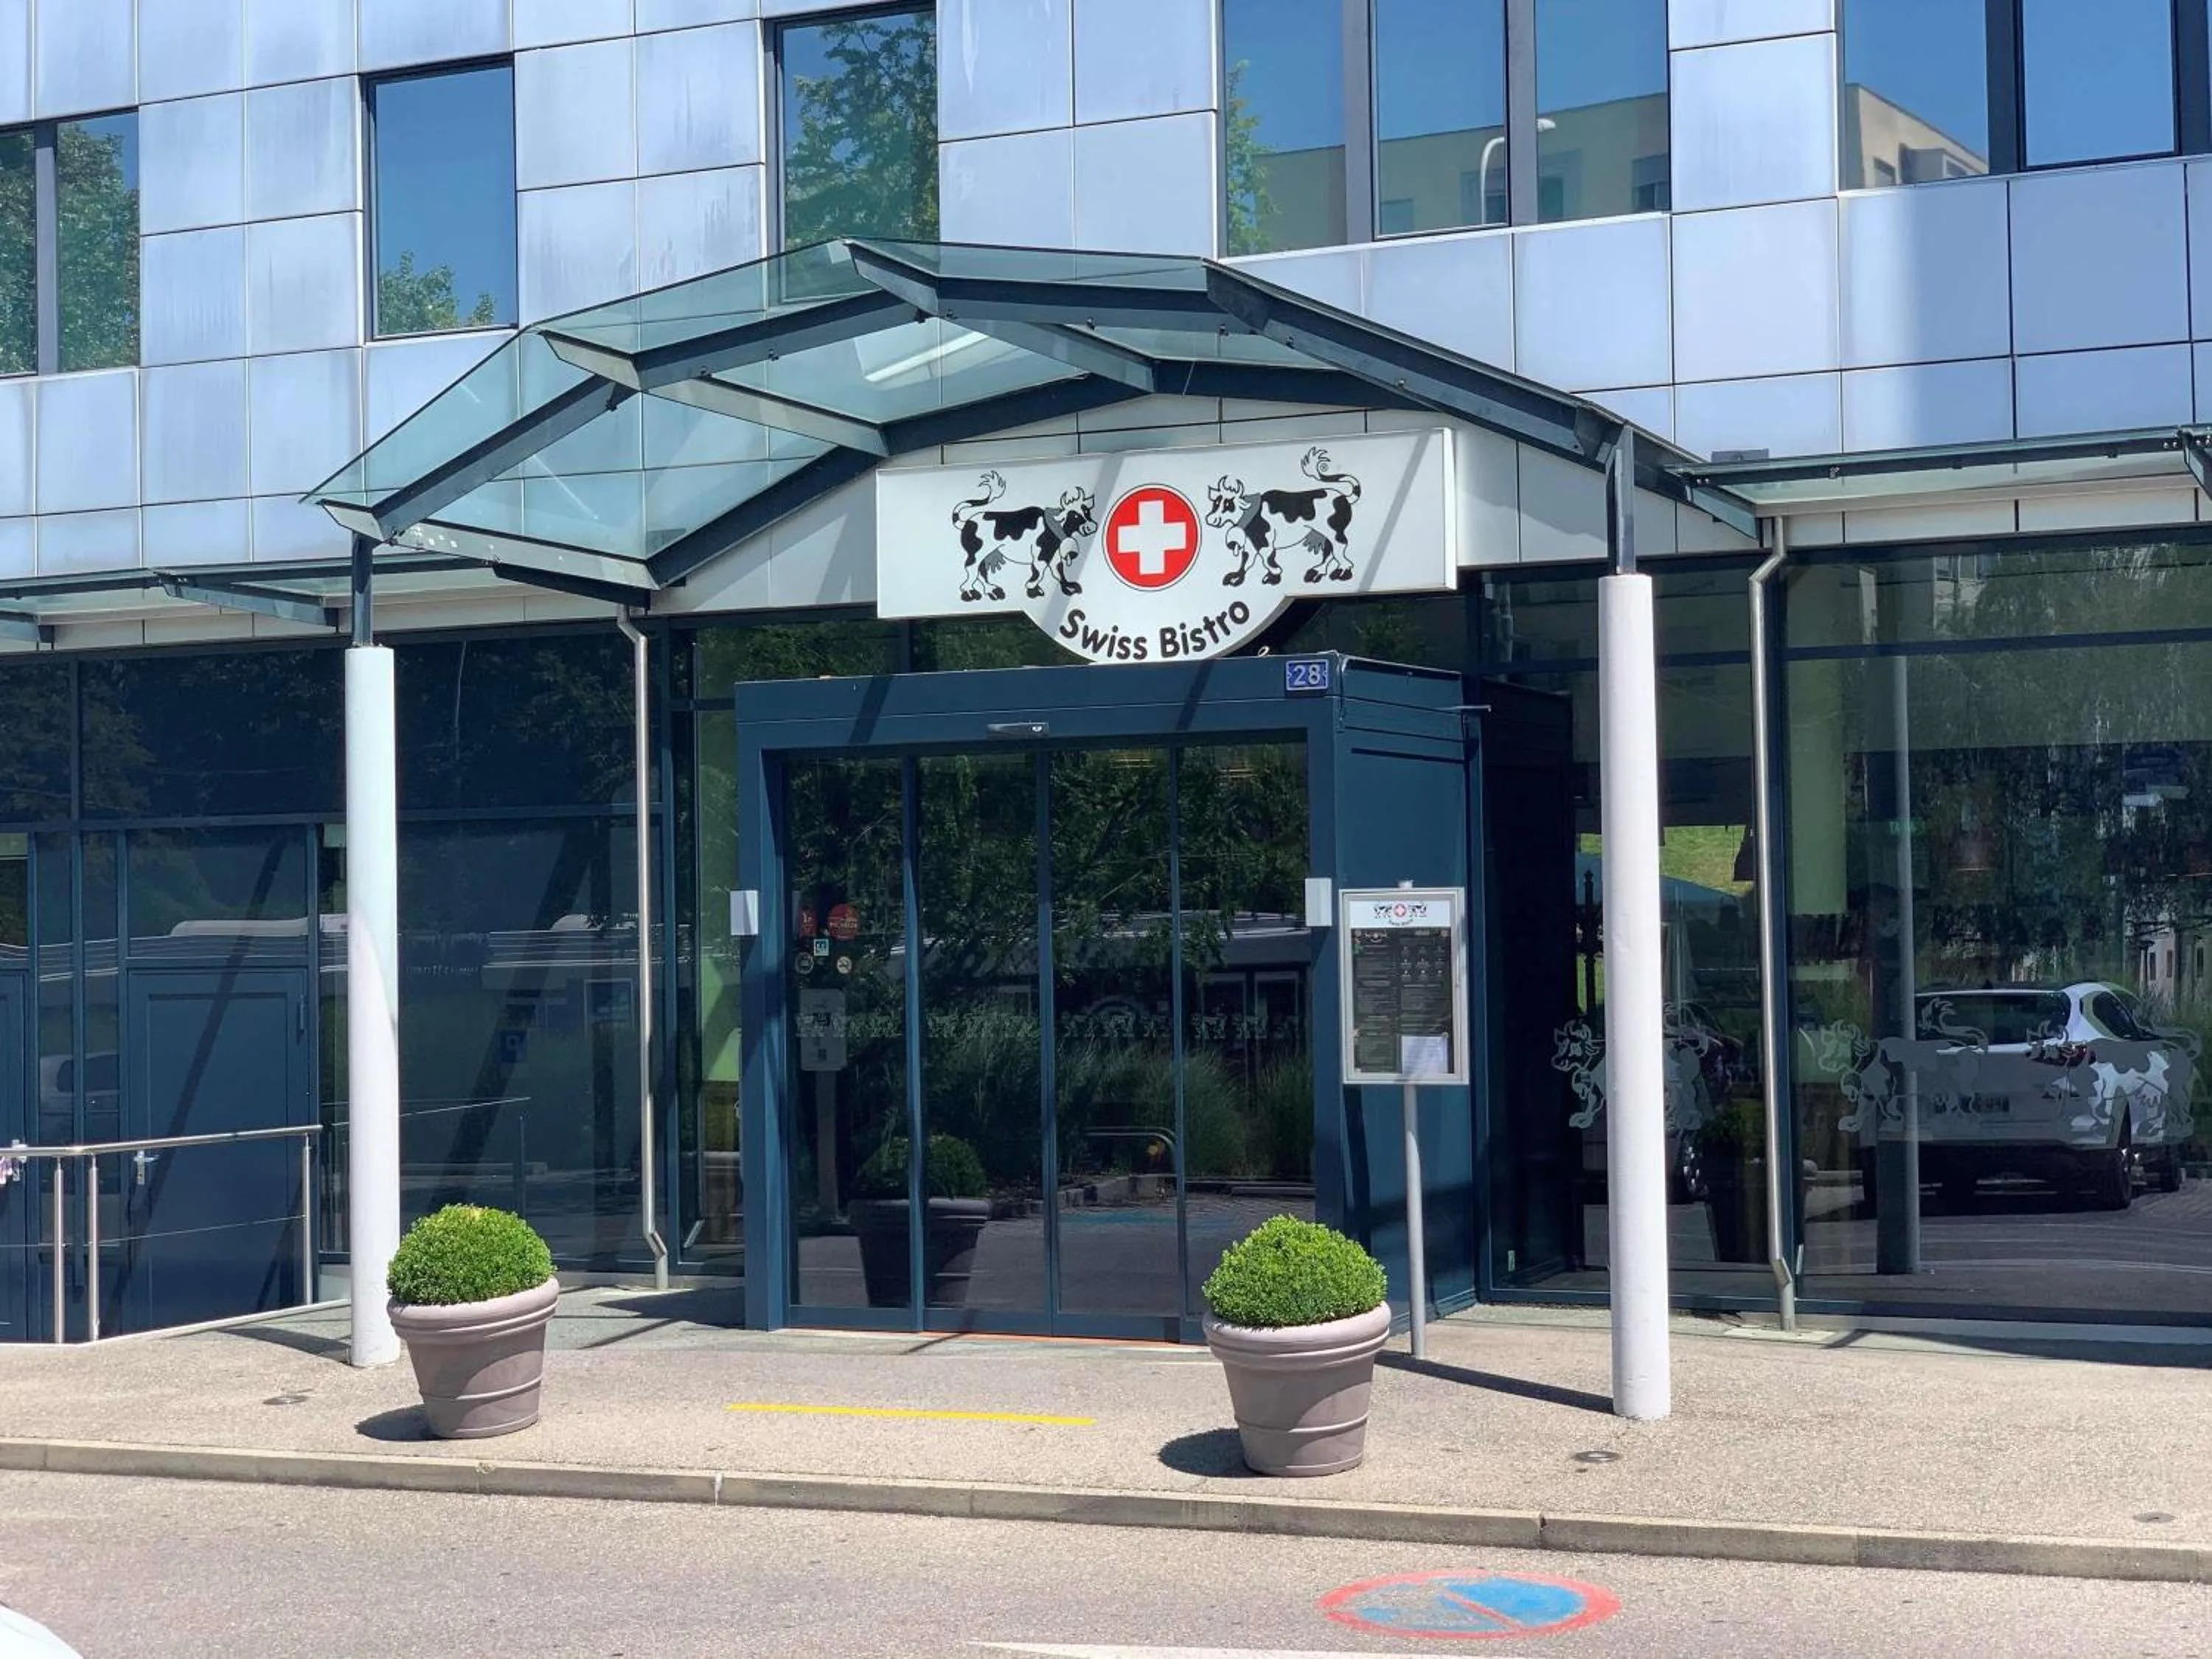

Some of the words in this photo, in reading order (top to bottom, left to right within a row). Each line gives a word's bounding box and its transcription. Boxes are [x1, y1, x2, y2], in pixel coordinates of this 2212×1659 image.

[1060, 608, 1147, 660] Swiss
[1159, 601, 1250, 658] Bistro
[1293, 664, 1321, 685] 28
